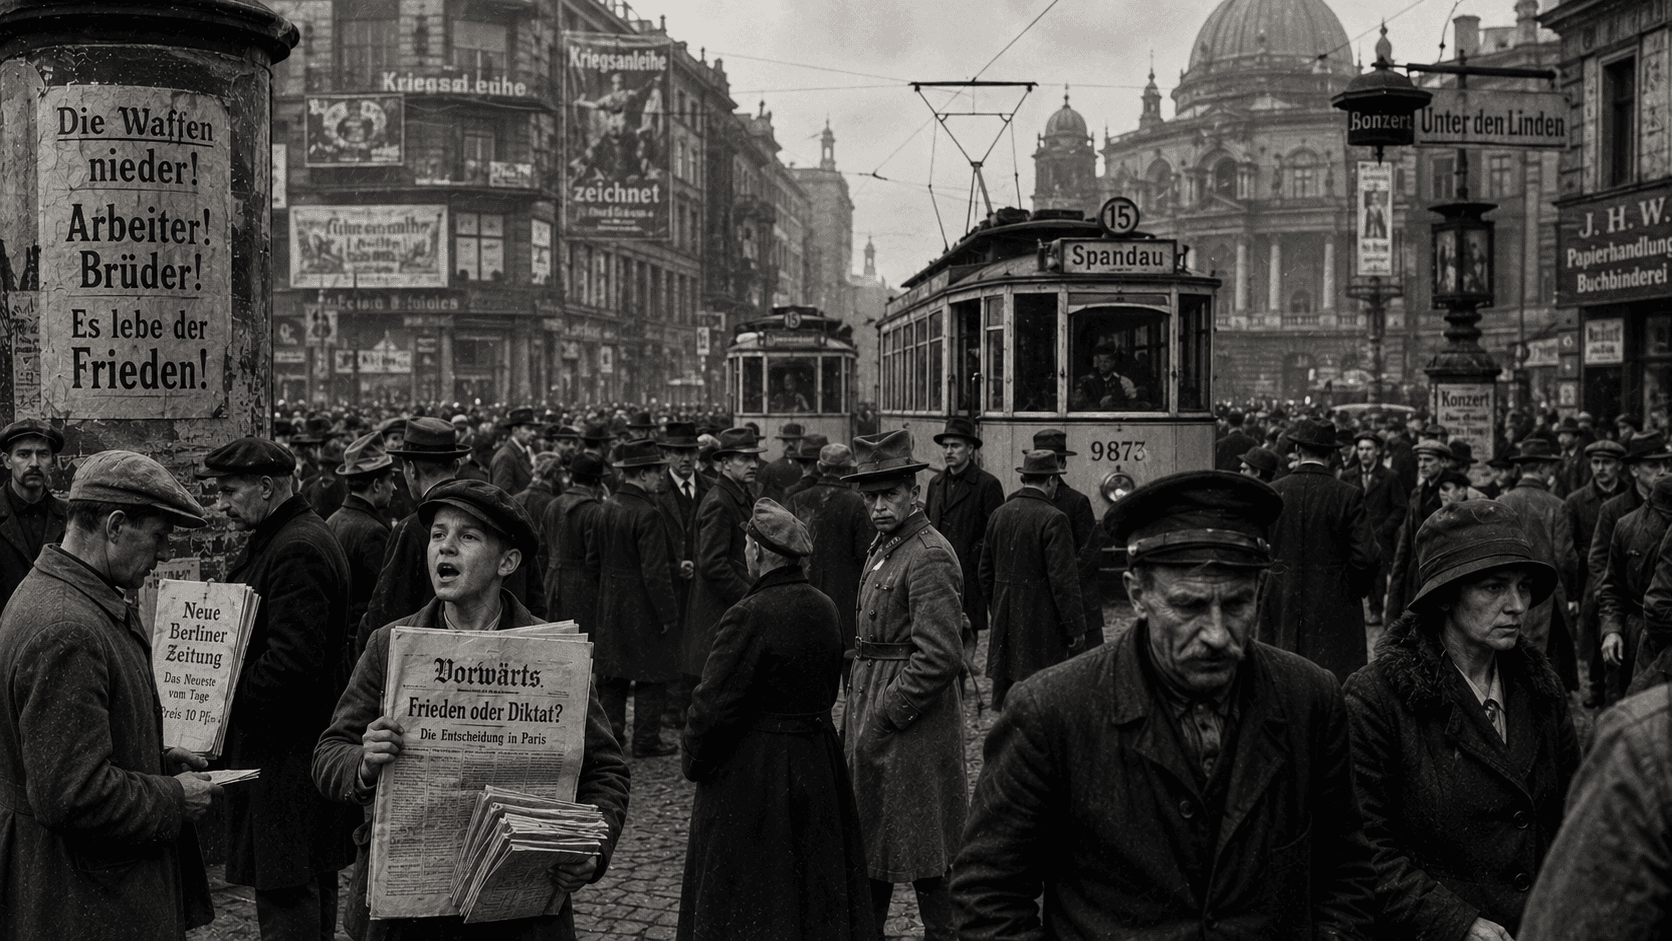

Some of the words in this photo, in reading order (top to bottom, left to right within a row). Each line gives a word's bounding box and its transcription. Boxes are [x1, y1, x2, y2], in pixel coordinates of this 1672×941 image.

[569, 45, 666, 73] Kriegsanleihe
[57, 106, 105, 136] Die
[117, 106, 214, 144] Waffen
[1421, 107, 1470, 134] Unter
[1474, 109, 1503, 135] den
[1508, 109, 1565, 137] Linden
[89, 148, 199, 186] nieder!
[574, 181, 660, 203] zeichnet
[66, 203, 211, 246] Arbeiter!
[1107, 204, 1131, 229] 15
[1579, 212, 1599, 239] J.
[1606, 204, 1633, 234] H.
[1638, 196, 1670, 227] W.
[1072, 244, 1163, 270] Spandau
[80, 250, 202, 291] Brüder!
[1577, 262, 1667, 293] Buchbinderei
[71, 308, 100, 339] Es
[112, 308, 163, 340] lebe
[173, 309, 208, 340] der
[71, 347, 208, 391] Frieden!
[1441, 391, 1490, 407] Konzert
[1091, 441, 1146, 461] 9873
[182, 601, 220, 620] Neue
[168, 622, 228, 643] Berliner
[165, 644, 223, 669] Zeitung
[164, 671, 181, 684] Das
[184, 674, 216, 687] Neueste
[190, 689, 210, 704] Tage
[407, 696, 466, 720] Frieden
[470, 700, 504, 721] oder
[507, 701, 563, 723] Diktat?
[185, 709, 196, 721] 10
[420, 727, 437, 741] Die
[440, 728, 505, 746] Entscheidung
[507, 731, 518, 744] in
[521, 731, 547, 745] Paris
